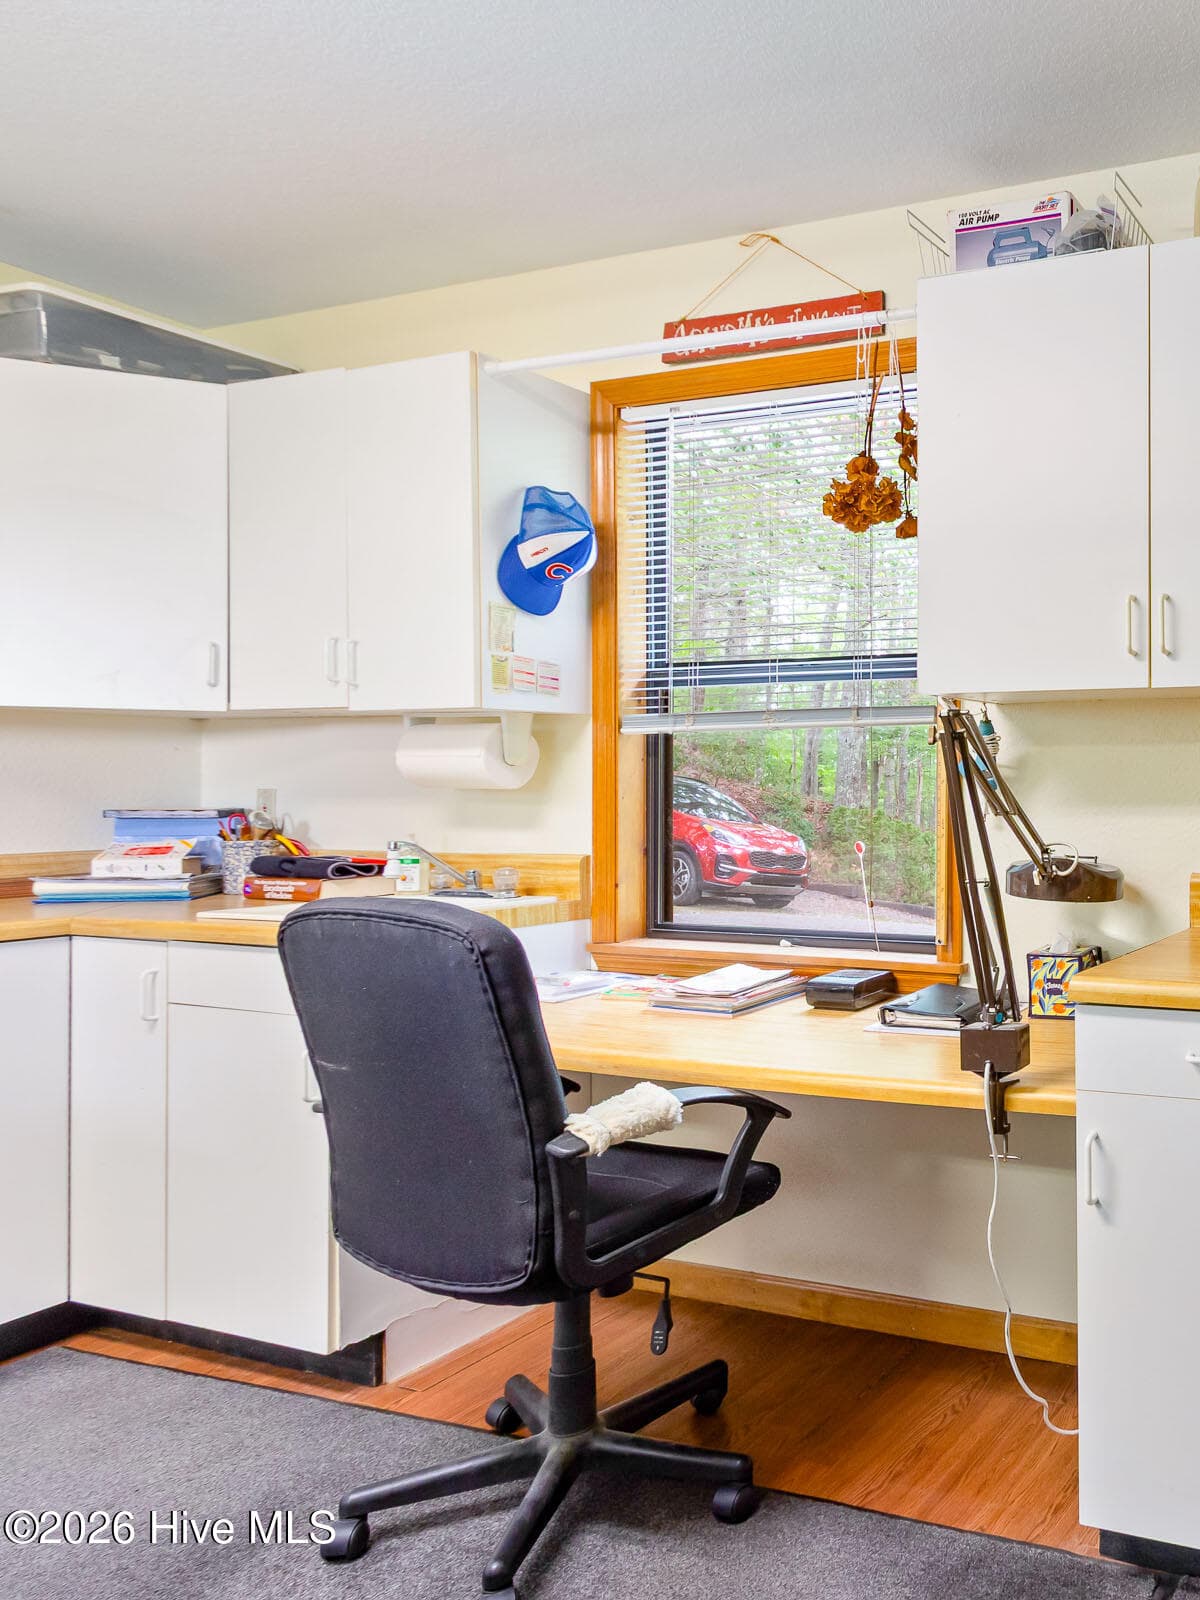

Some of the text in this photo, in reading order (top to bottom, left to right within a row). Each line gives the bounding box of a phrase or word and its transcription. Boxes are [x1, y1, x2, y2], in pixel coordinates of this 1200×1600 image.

[958, 213, 1000, 227] AIR PUMP
[545, 562, 574, 580] C
